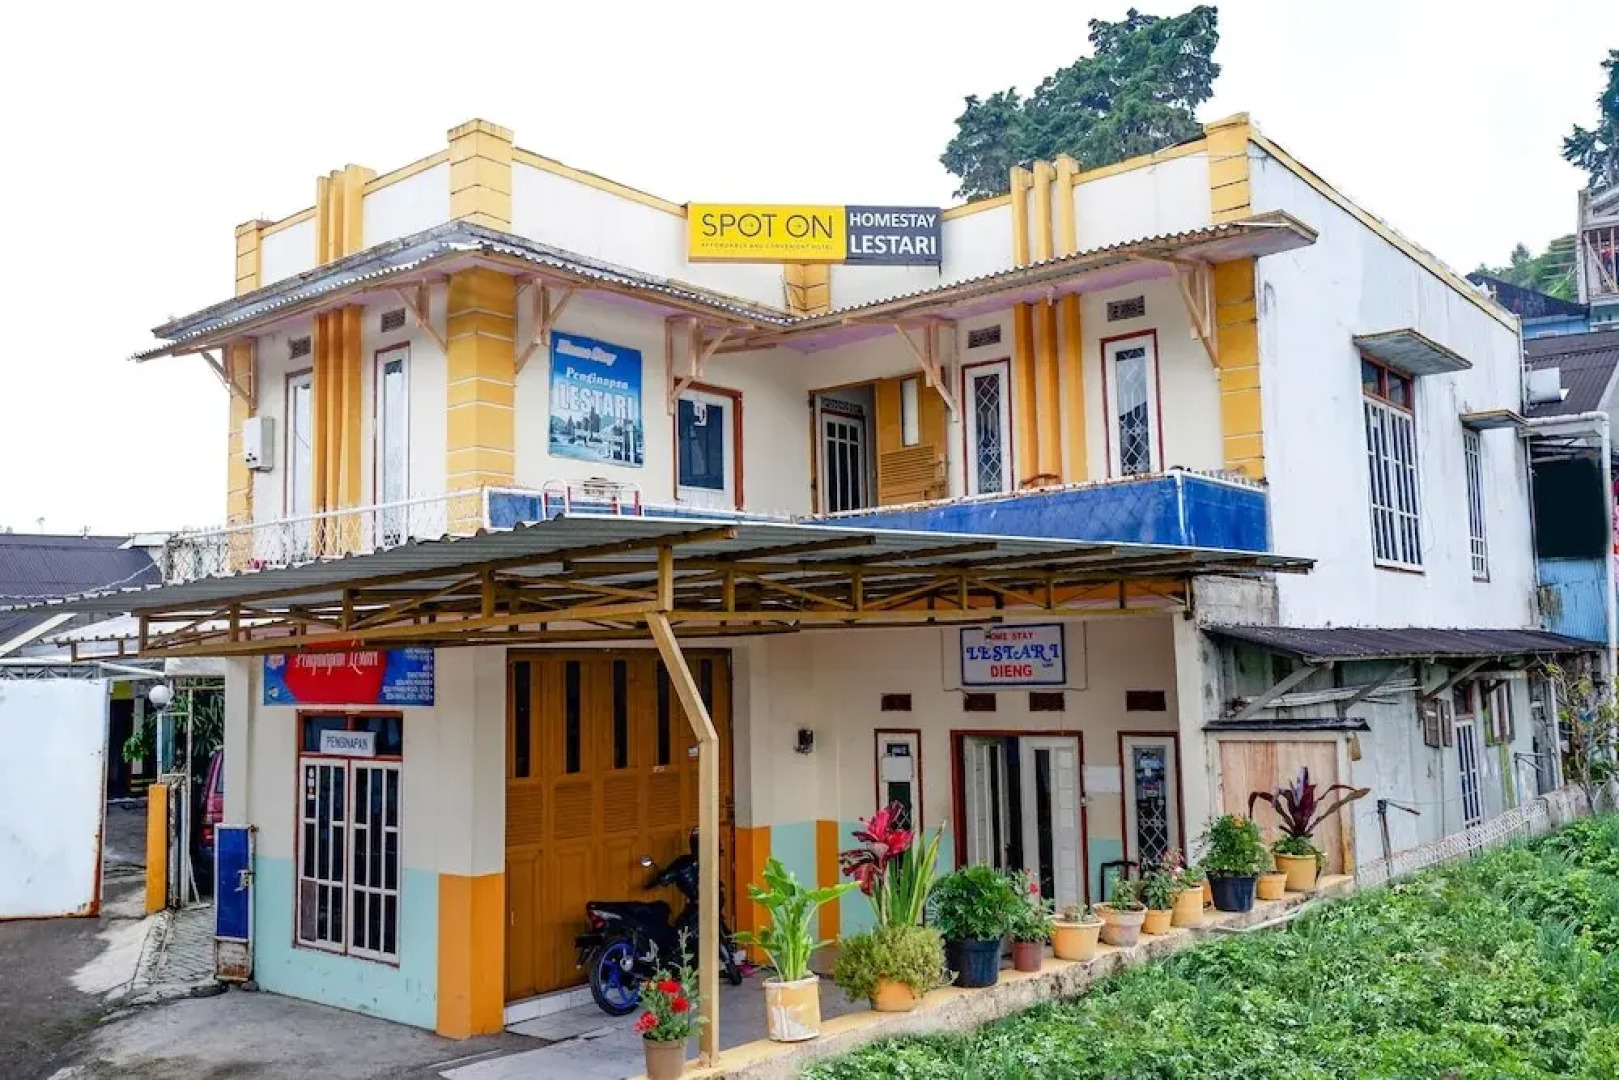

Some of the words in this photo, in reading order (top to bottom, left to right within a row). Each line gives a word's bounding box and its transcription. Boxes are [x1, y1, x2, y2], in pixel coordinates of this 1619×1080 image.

[702, 213, 777, 238] SPOT
[786, 214, 833, 238] ON
[850, 213, 936, 228] HOMESTAY
[850, 235, 936, 254] LESTARI
[558, 382, 634, 420] LESTARI
[1012, 631, 1034, 640] STAY
[966, 643, 1060, 662] LESTARI
[990, 664, 1032, 678] DIENG
